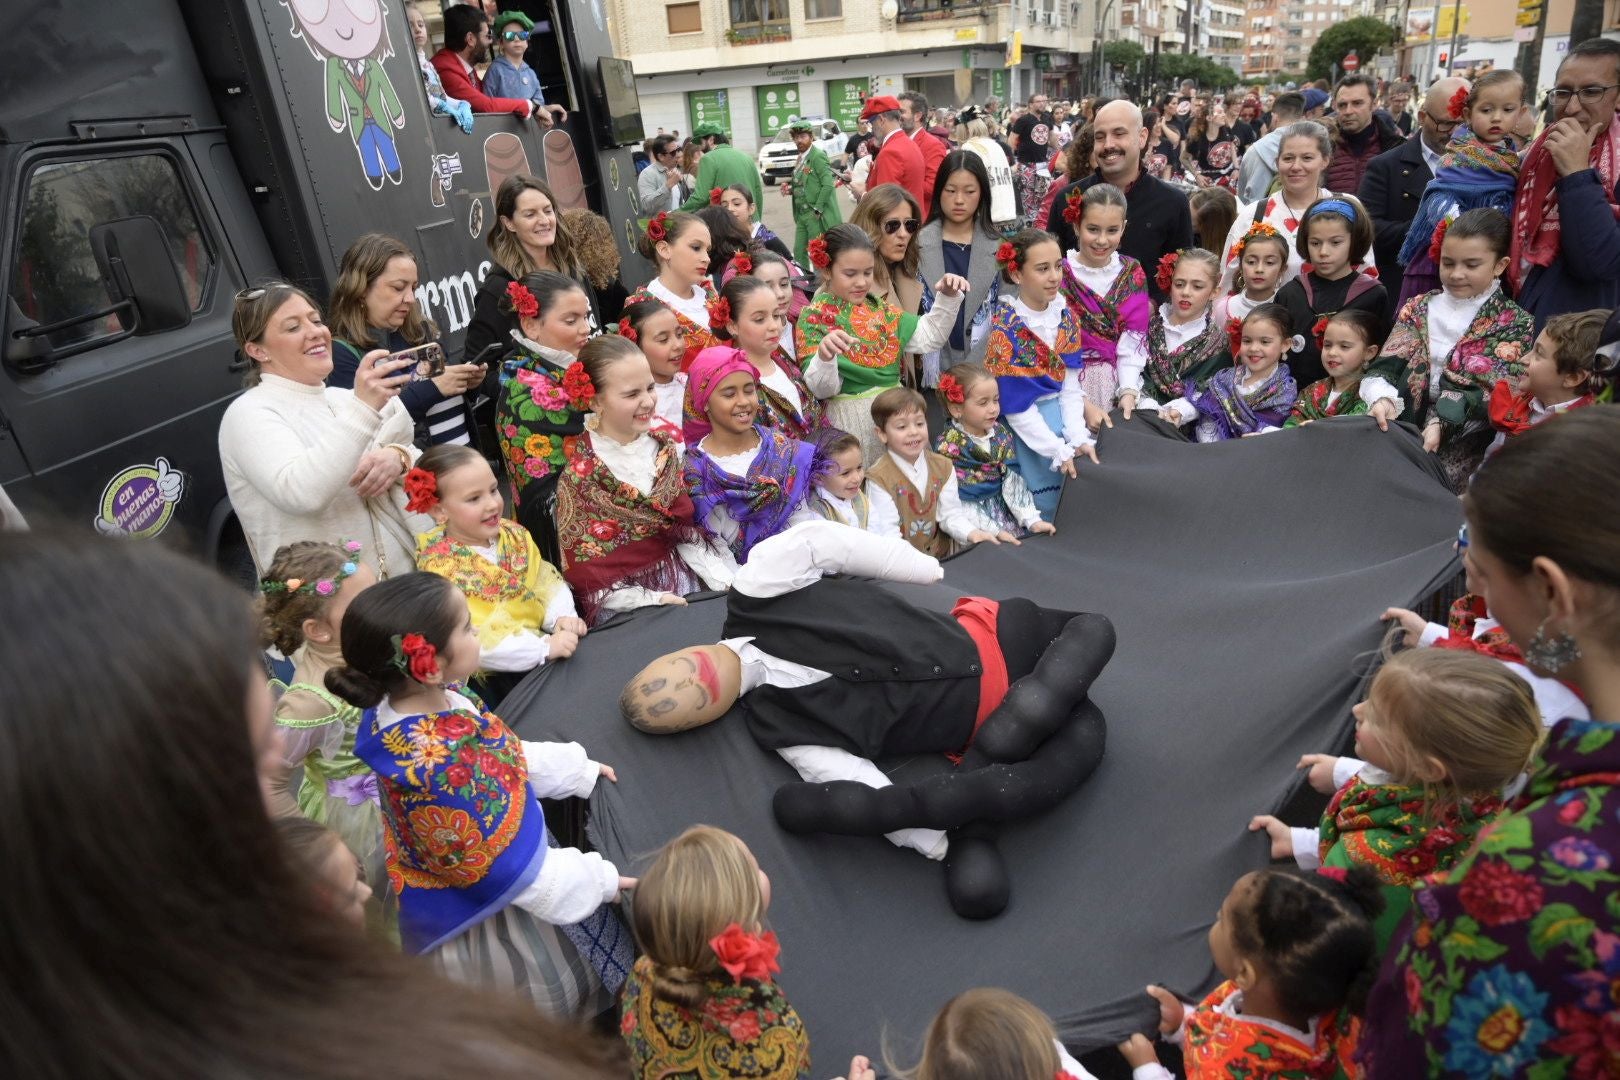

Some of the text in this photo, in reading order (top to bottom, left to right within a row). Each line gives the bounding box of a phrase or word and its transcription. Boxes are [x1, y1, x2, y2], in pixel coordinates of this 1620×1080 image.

[767, 68, 799, 77] Carrefour
[113, 483, 156, 528] buenas
[119, 486, 135, 506] en
[127, 490, 166, 533] manos
